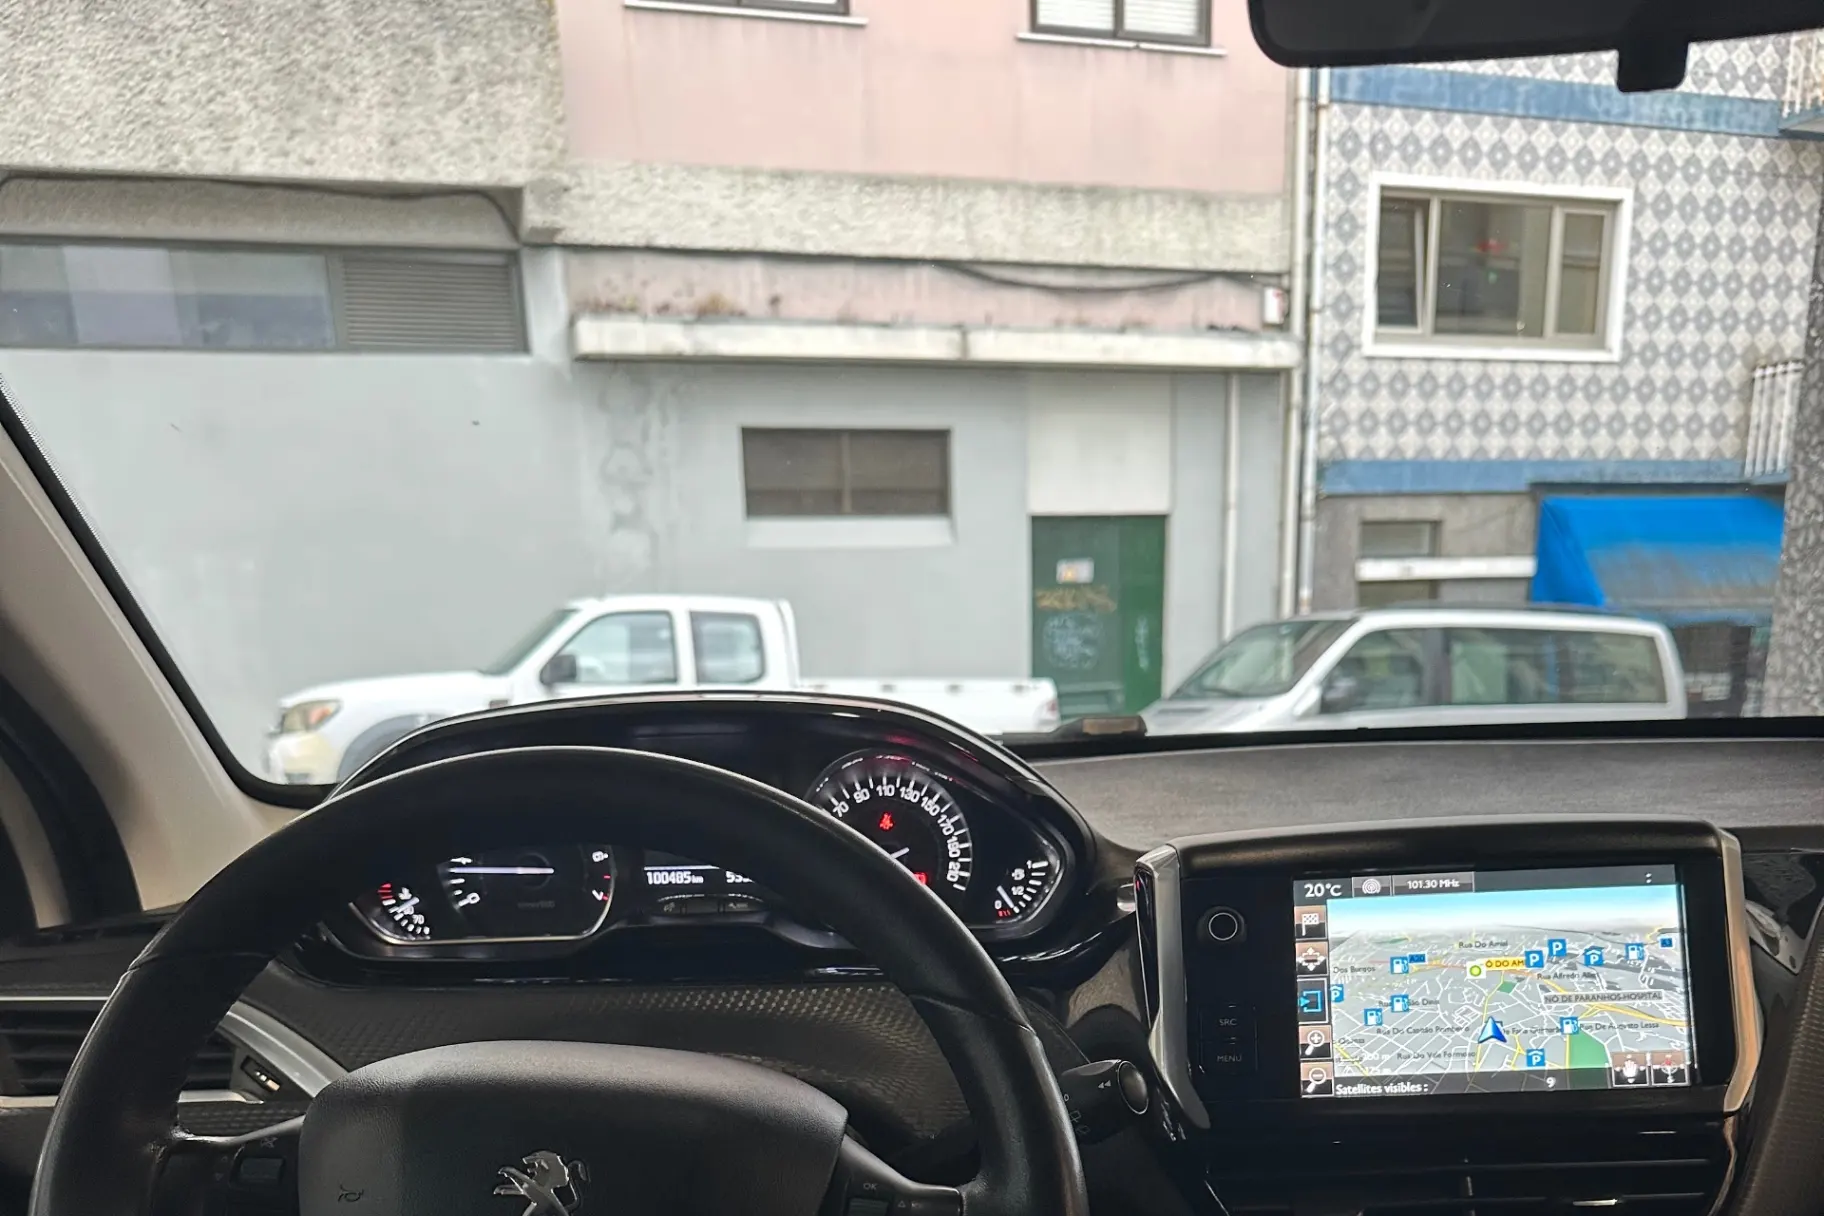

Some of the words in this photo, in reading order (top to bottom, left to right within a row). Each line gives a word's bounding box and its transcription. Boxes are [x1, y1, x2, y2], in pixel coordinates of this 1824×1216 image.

[853, 788, 871, 804] 90
[876, 785, 895, 797] 110
[900, 786, 920, 803] 130
[832, 801, 849, 818] 70
[920, 797, 940, 817] 150
[937, 813, 955, 836] 170
[946, 861, 961, 882] 210
[1304, 882, 1342, 898] 20°C
[1407, 880, 1438, 890] 101.30
[1439, 878, 1460, 888] MHz
[1459, 941, 1473, 949] Rua
[1476, 940, 1487, 948] Do
[1350, 965, 1376, 975] Burgos
[1495, 960, 1510, 968] DO
[1553, 971, 1579, 979] Alfredo
[1560, 994, 1574, 1003] DE
[1219, 1018, 1237, 1026] SRC
[1641, 1021, 1660, 1029] Lessa
[1217, 1054, 1242, 1062] MENU
[1335, 1083, 1382, 1095] Satellites
[1384, 1082, 1421, 1093] visibles
[1546, 1076, 1556, 1088] 9
